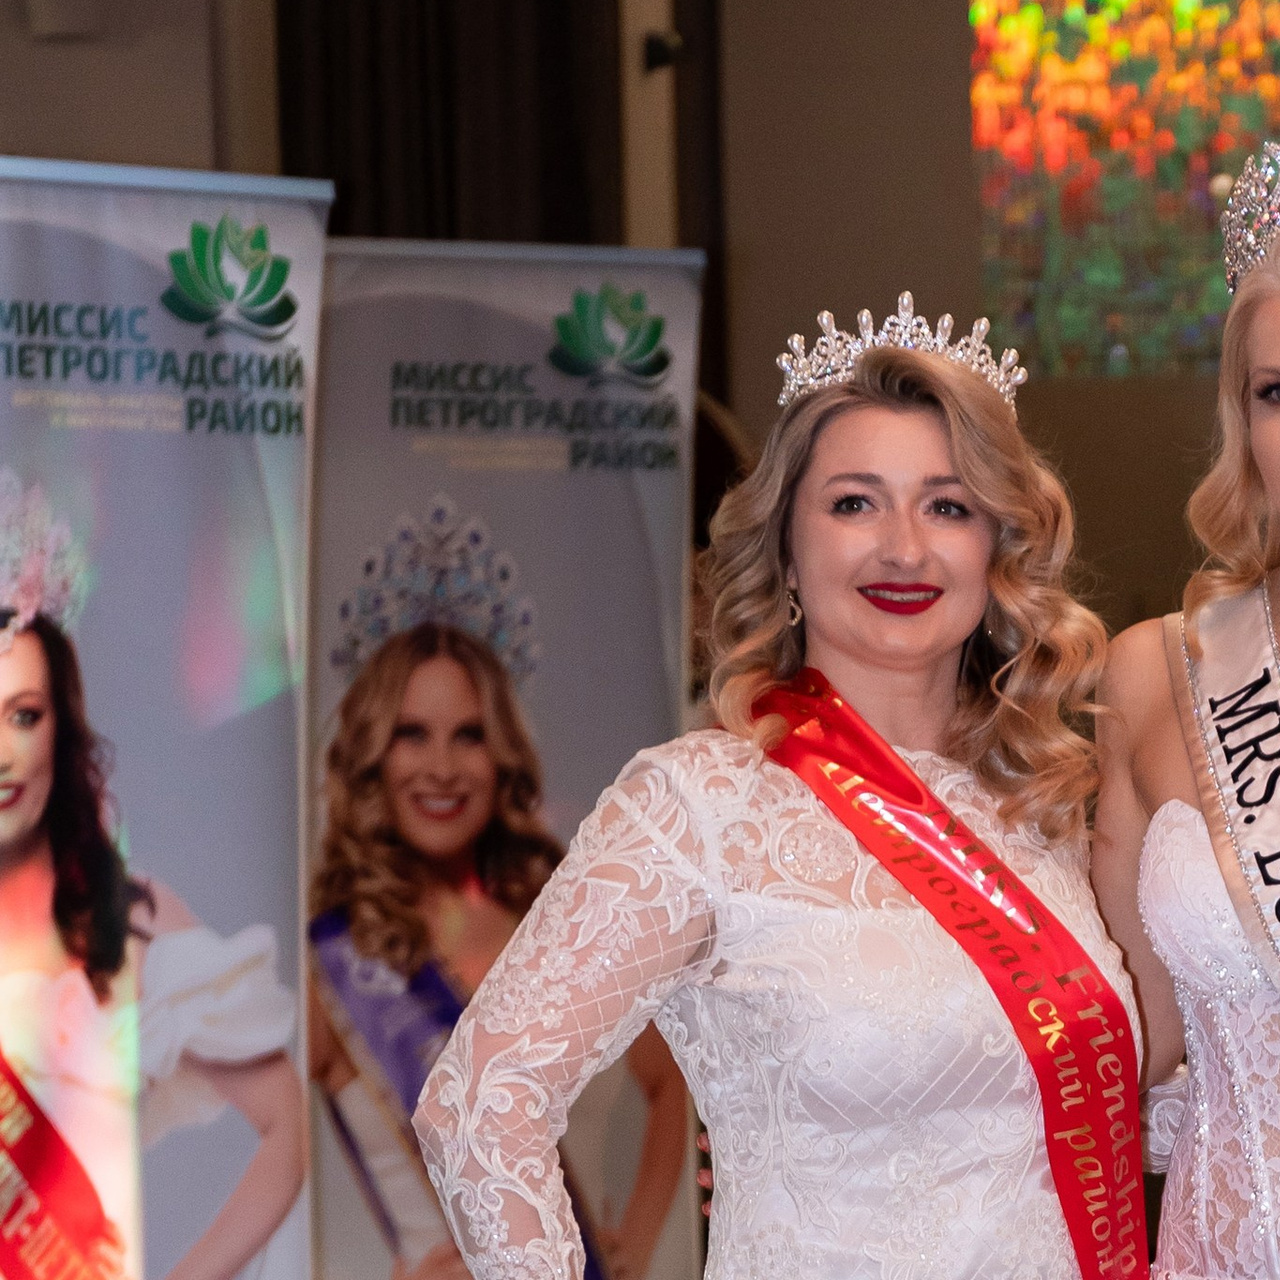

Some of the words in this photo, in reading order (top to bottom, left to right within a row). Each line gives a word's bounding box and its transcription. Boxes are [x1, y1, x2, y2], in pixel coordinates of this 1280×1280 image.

[186, 396, 304, 435] РАЙОН
[818, 761, 1085, 1113] Петроградский
[1054, 1121, 1114, 1275] район
[1053, 963, 1142, 1278] Friendship
